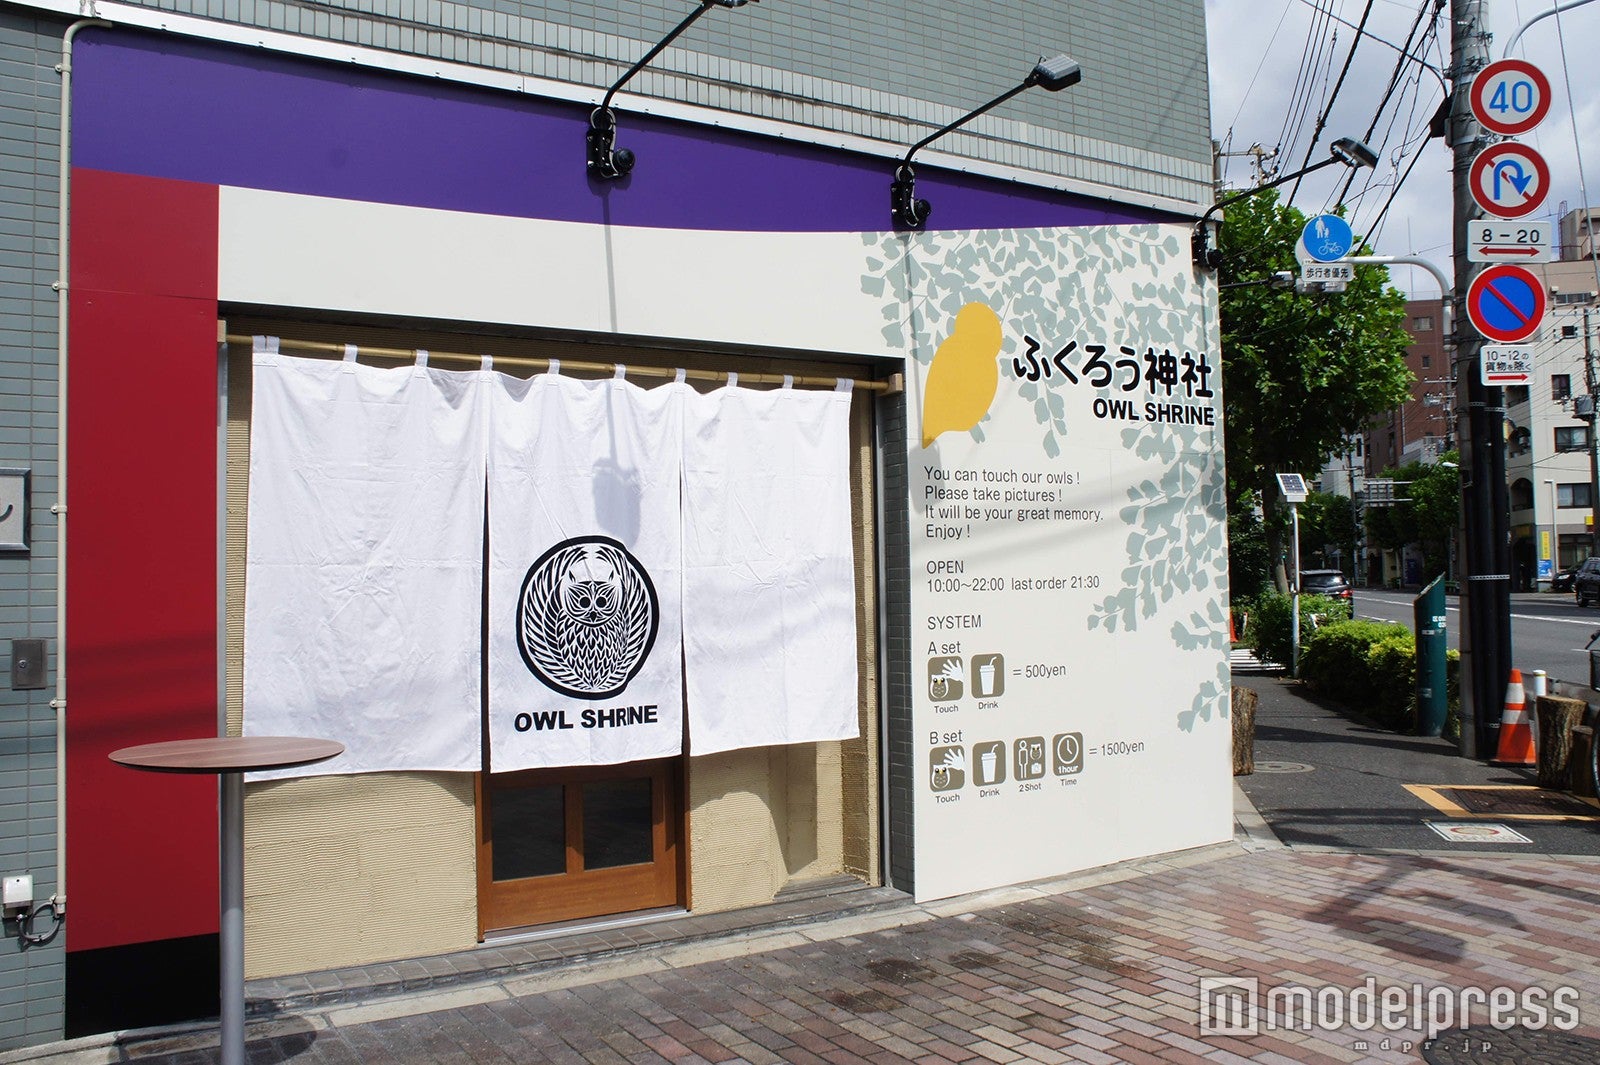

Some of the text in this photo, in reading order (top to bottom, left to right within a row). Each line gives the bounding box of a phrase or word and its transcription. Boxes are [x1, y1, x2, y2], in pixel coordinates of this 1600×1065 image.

[1489, 81, 1533, 113] 40
[1306, 267, 1349, 278] 歩行者優先
[1013, 335, 1214, 398] ふくろう神社
[1093, 398, 1215, 426] OWL SHRINE
[924, 466, 950, 480] You
[954, 469, 978, 482] can
[982, 469, 1018, 483] touch
[1021, 472, 1042, 484] our
[925, 485, 969, 500] Please
[973, 487, 1001, 501] take
[925, 504, 1104, 523] It will be your great memory.
[926, 560, 964, 574] OPEN
[1011, 577, 1033, 591] last
[1035, 576, 1067, 590] order
[1070, 575, 1100, 589] 21:30
[927, 614, 982, 630] SYSTEM
[927, 640, 961, 655] A set
[1025, 663, 1067, 679] 500yen
[934, 704, 959, 714] Touch
[978, 701, 999, 710] Drink
[514, 710, 574, 732] OWL
[929, 729, 963, 744] B set
[1101, 740, 1145, 757] 1500yen
[1060, 778, 1078, 787] Time
[935, 793, 961, 803] Touch
[979, 788, 1000, 798] Drink
